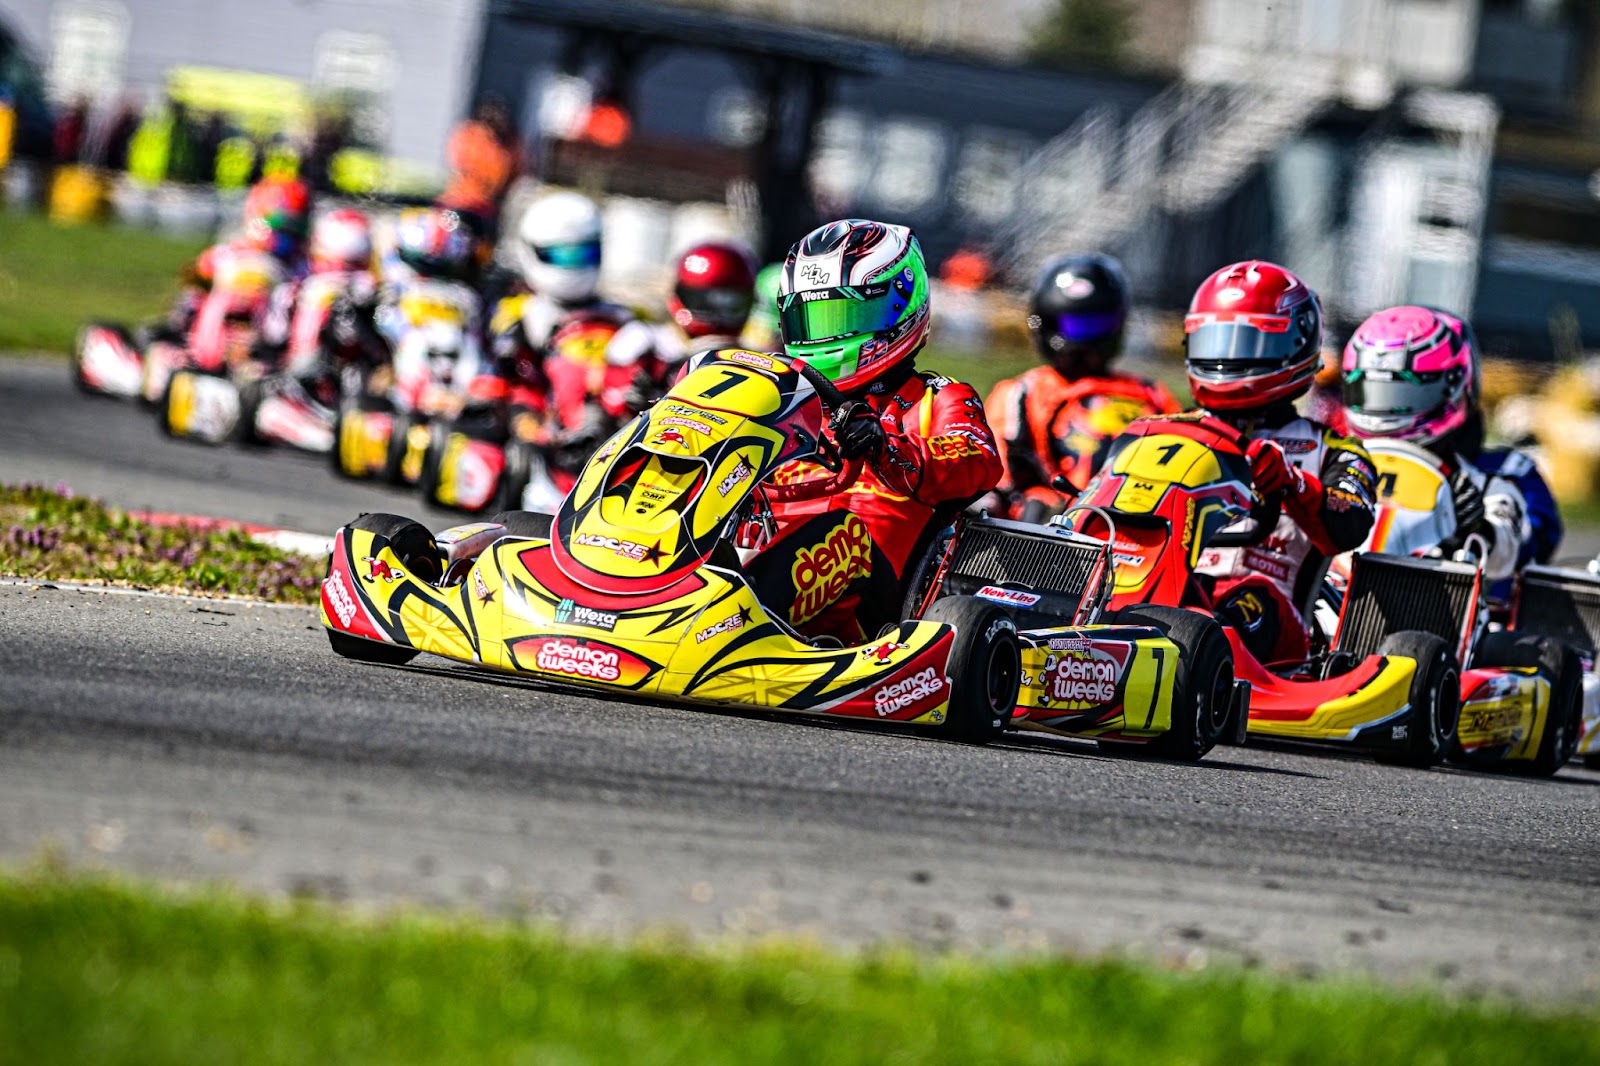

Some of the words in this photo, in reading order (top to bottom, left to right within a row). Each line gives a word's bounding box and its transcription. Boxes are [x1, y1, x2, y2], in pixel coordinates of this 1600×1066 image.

[801, 290, 830, 302] Wera
[698, 370, 750, 399] 7
[1156, 443, 1185, 466] 1
[642, 491, 665, 500] OMP
[330, 569, 357, 618] demon
[981, 586, 1036, 604] New-Line
[574, 606, 618, 625] Wera
[537, 651, 620, 680] tweeks
[542, 641, 618, 667] demon
[1058, 654, 1114, 682] demon
[874, 666, 936, 703] demon
[875, 677, 943, 717] tweeks
[1054, 676, 1115, 701] tweeks
